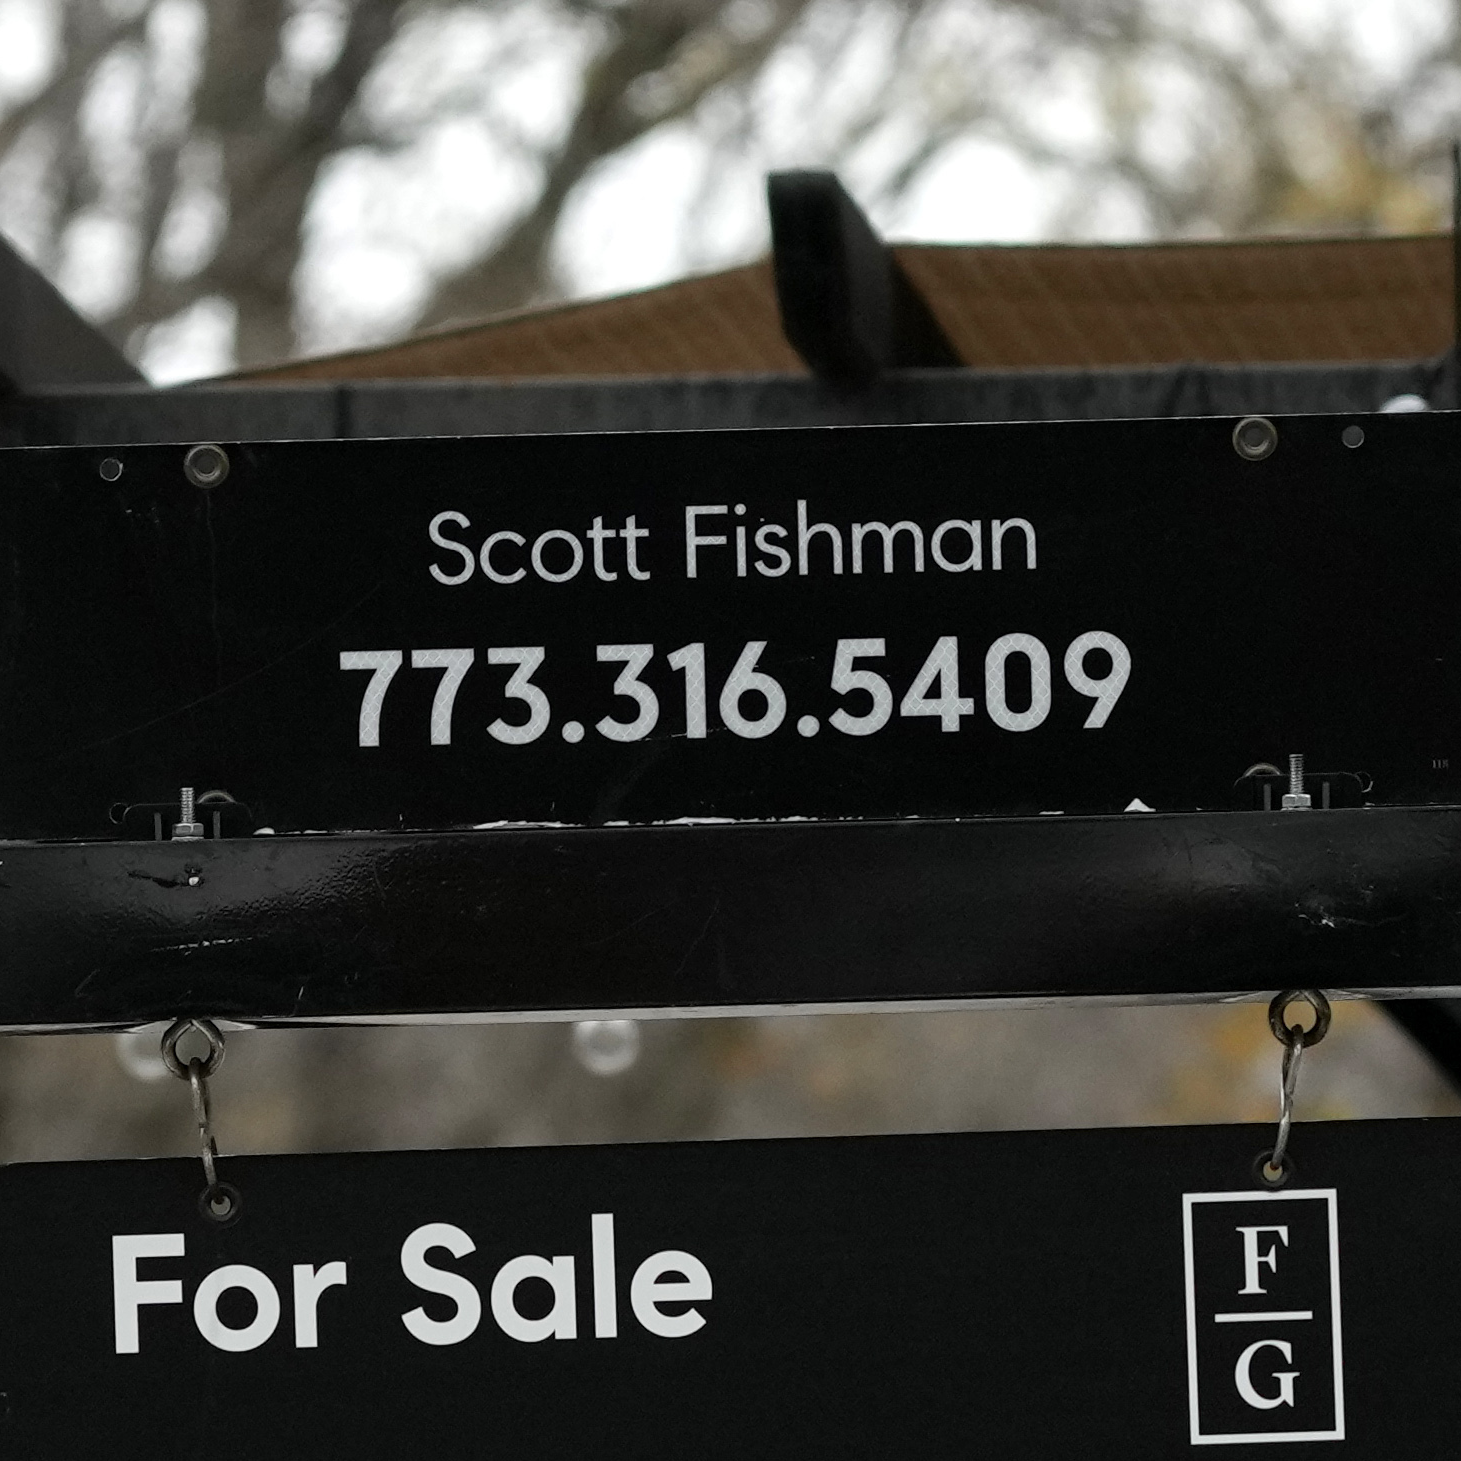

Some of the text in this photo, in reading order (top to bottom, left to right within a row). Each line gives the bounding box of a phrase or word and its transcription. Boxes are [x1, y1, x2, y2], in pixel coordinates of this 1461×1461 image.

[428, 499, 1037, 586] Scott Fishman
[339, 630, 1132, 747] 773.316.5409
[111, 1212, 713, 1355] For Sale
[1235, 1225, 1289, 1295] F
[1234, 1339, 1301, 1410] G
